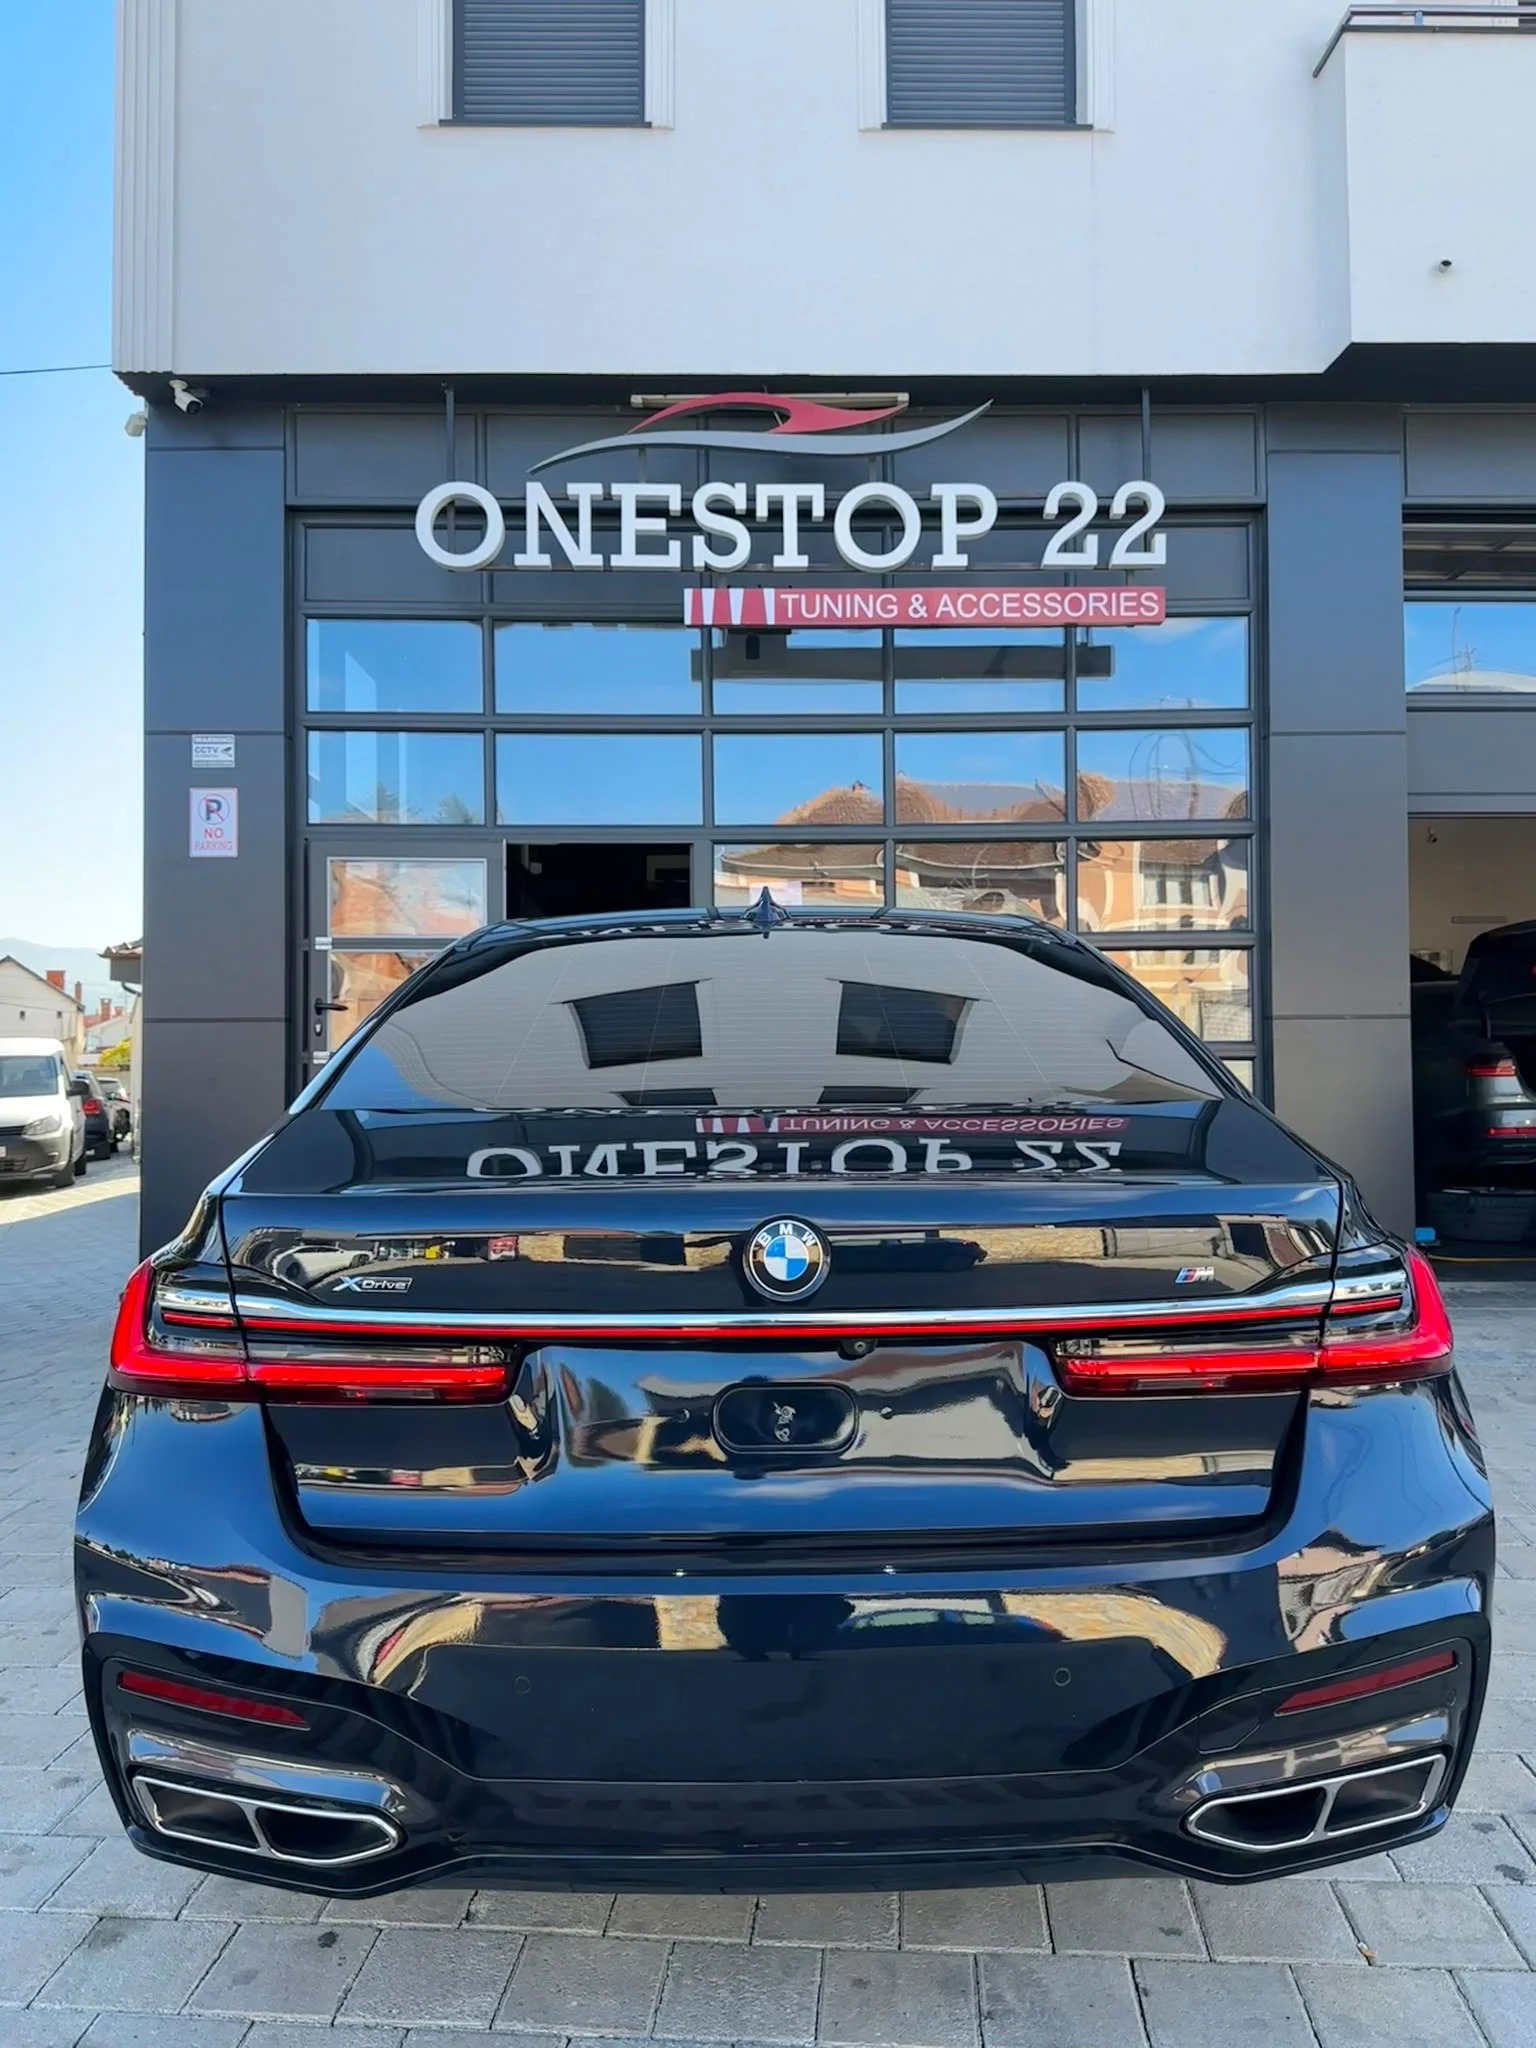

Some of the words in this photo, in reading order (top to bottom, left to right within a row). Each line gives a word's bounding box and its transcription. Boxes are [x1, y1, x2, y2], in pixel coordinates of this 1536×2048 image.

[415, 480, 998, 571] ONESTOP
[1041, 480, 1167, 569] 22
[780, 593, 898, 619] TUNING
[908, 593, 929, 618] &
[936, 592, 1160, 618] ACCESSORIES
[194, 746, 219, 754] CCTV
[204, 828, 224, 839] NO
[757, 1223, 816, 1247] BMW
